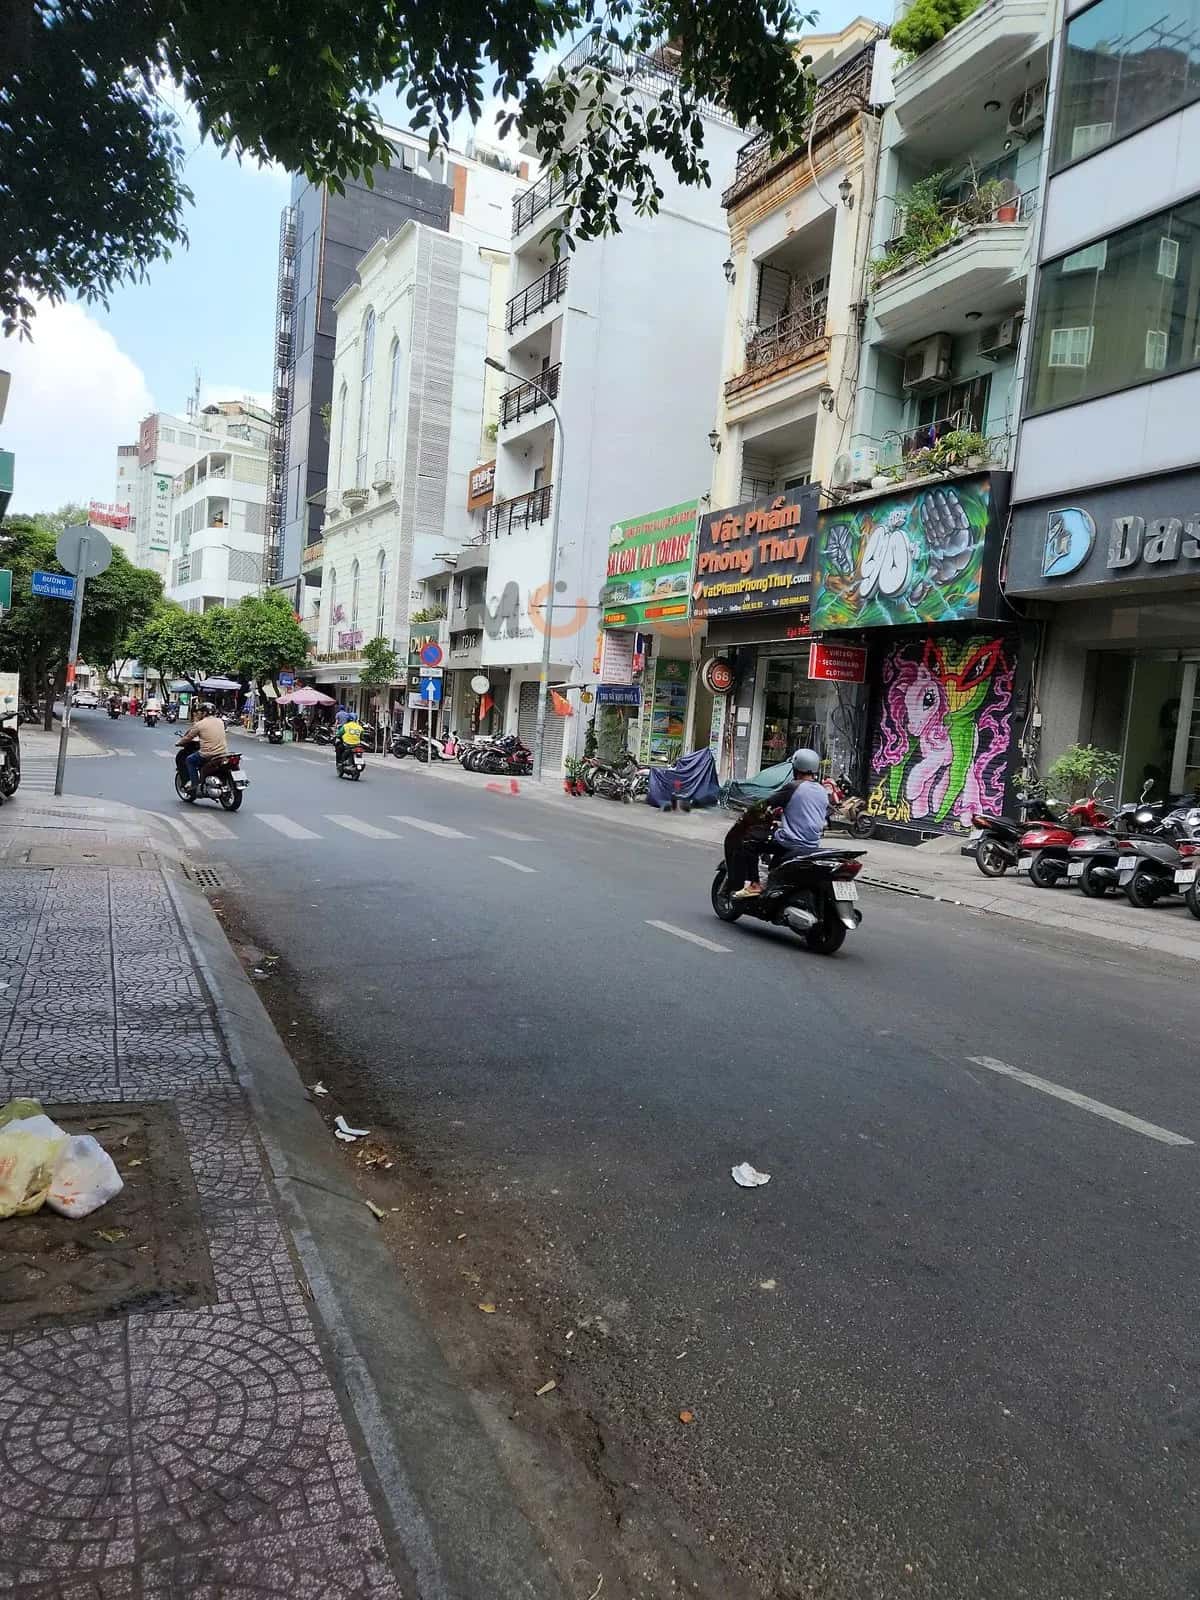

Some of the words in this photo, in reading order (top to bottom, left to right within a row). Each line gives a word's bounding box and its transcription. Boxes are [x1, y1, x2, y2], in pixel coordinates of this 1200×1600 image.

[710, 514, 742, 549] Vật
[744, 495, 802, 536] Phẩm
[656, 532, 693, 566] TOURIST
[699, 545, 755, 576] Phong
[758, 528, 811, 564] Thủy
[715, 671, 729, 681] 68
